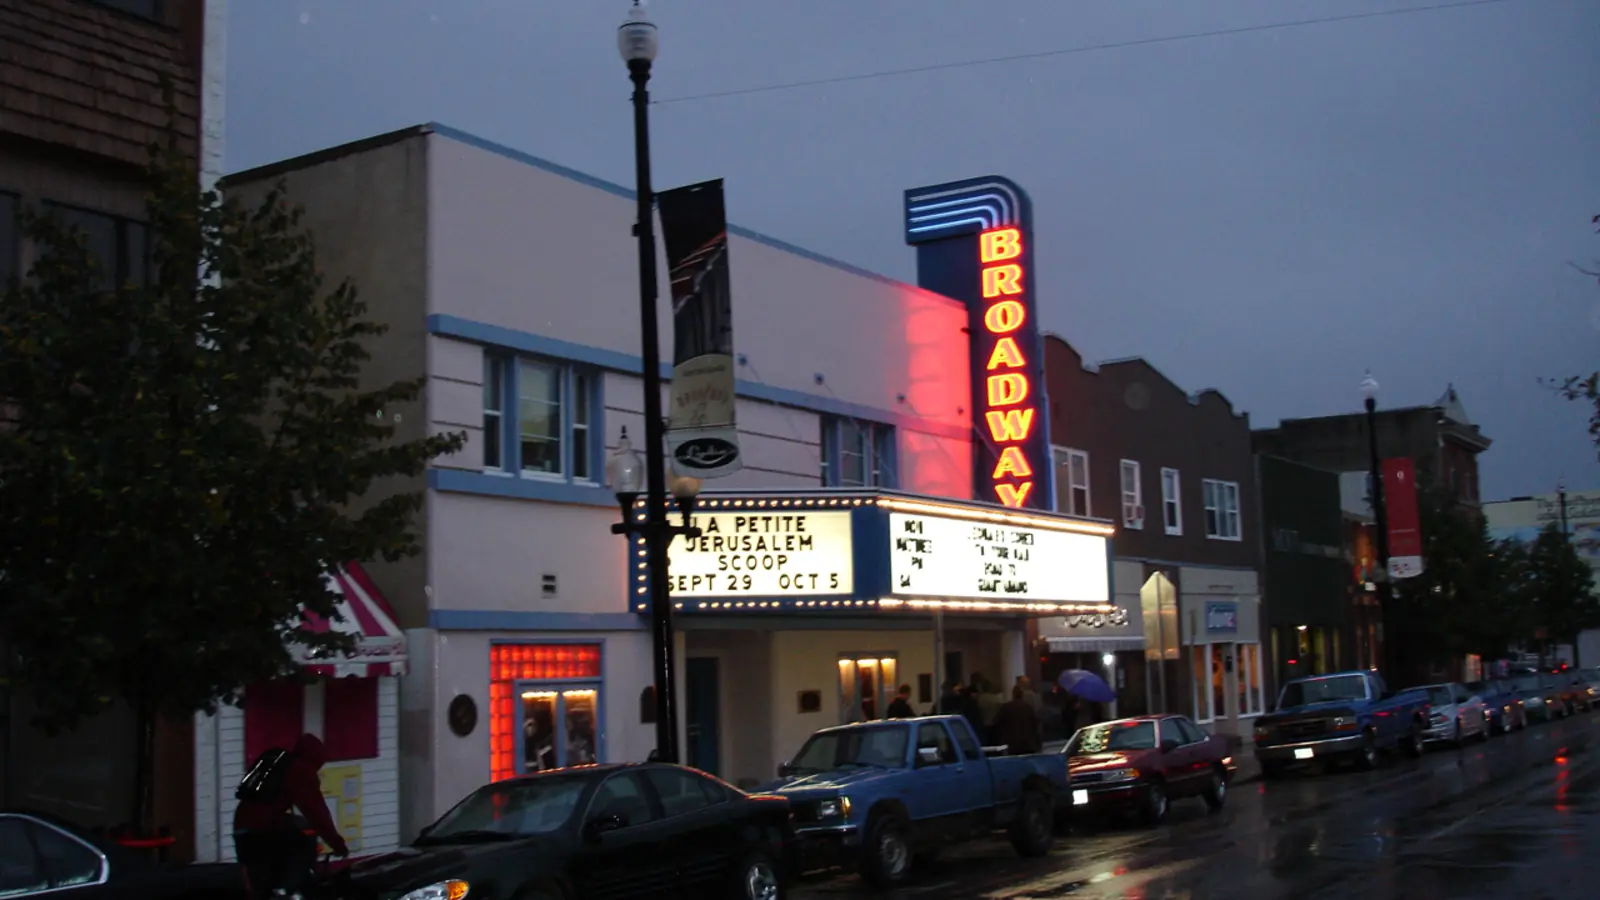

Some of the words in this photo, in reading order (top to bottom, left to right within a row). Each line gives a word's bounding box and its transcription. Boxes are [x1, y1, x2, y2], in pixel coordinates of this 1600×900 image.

[979, 227, 1035, 508] BROADWAY
[735, 515, 807, 533] PETITE
[686, 534, 814, 552] JERUSALEM
[718, 554, 789, 571] SCOOP
[668, 573, 717, 592] SEPT
[727, 574, 753, 591] 29
[779, 573, 819, 590] OCT
[829, 572, 839, 589] 5
